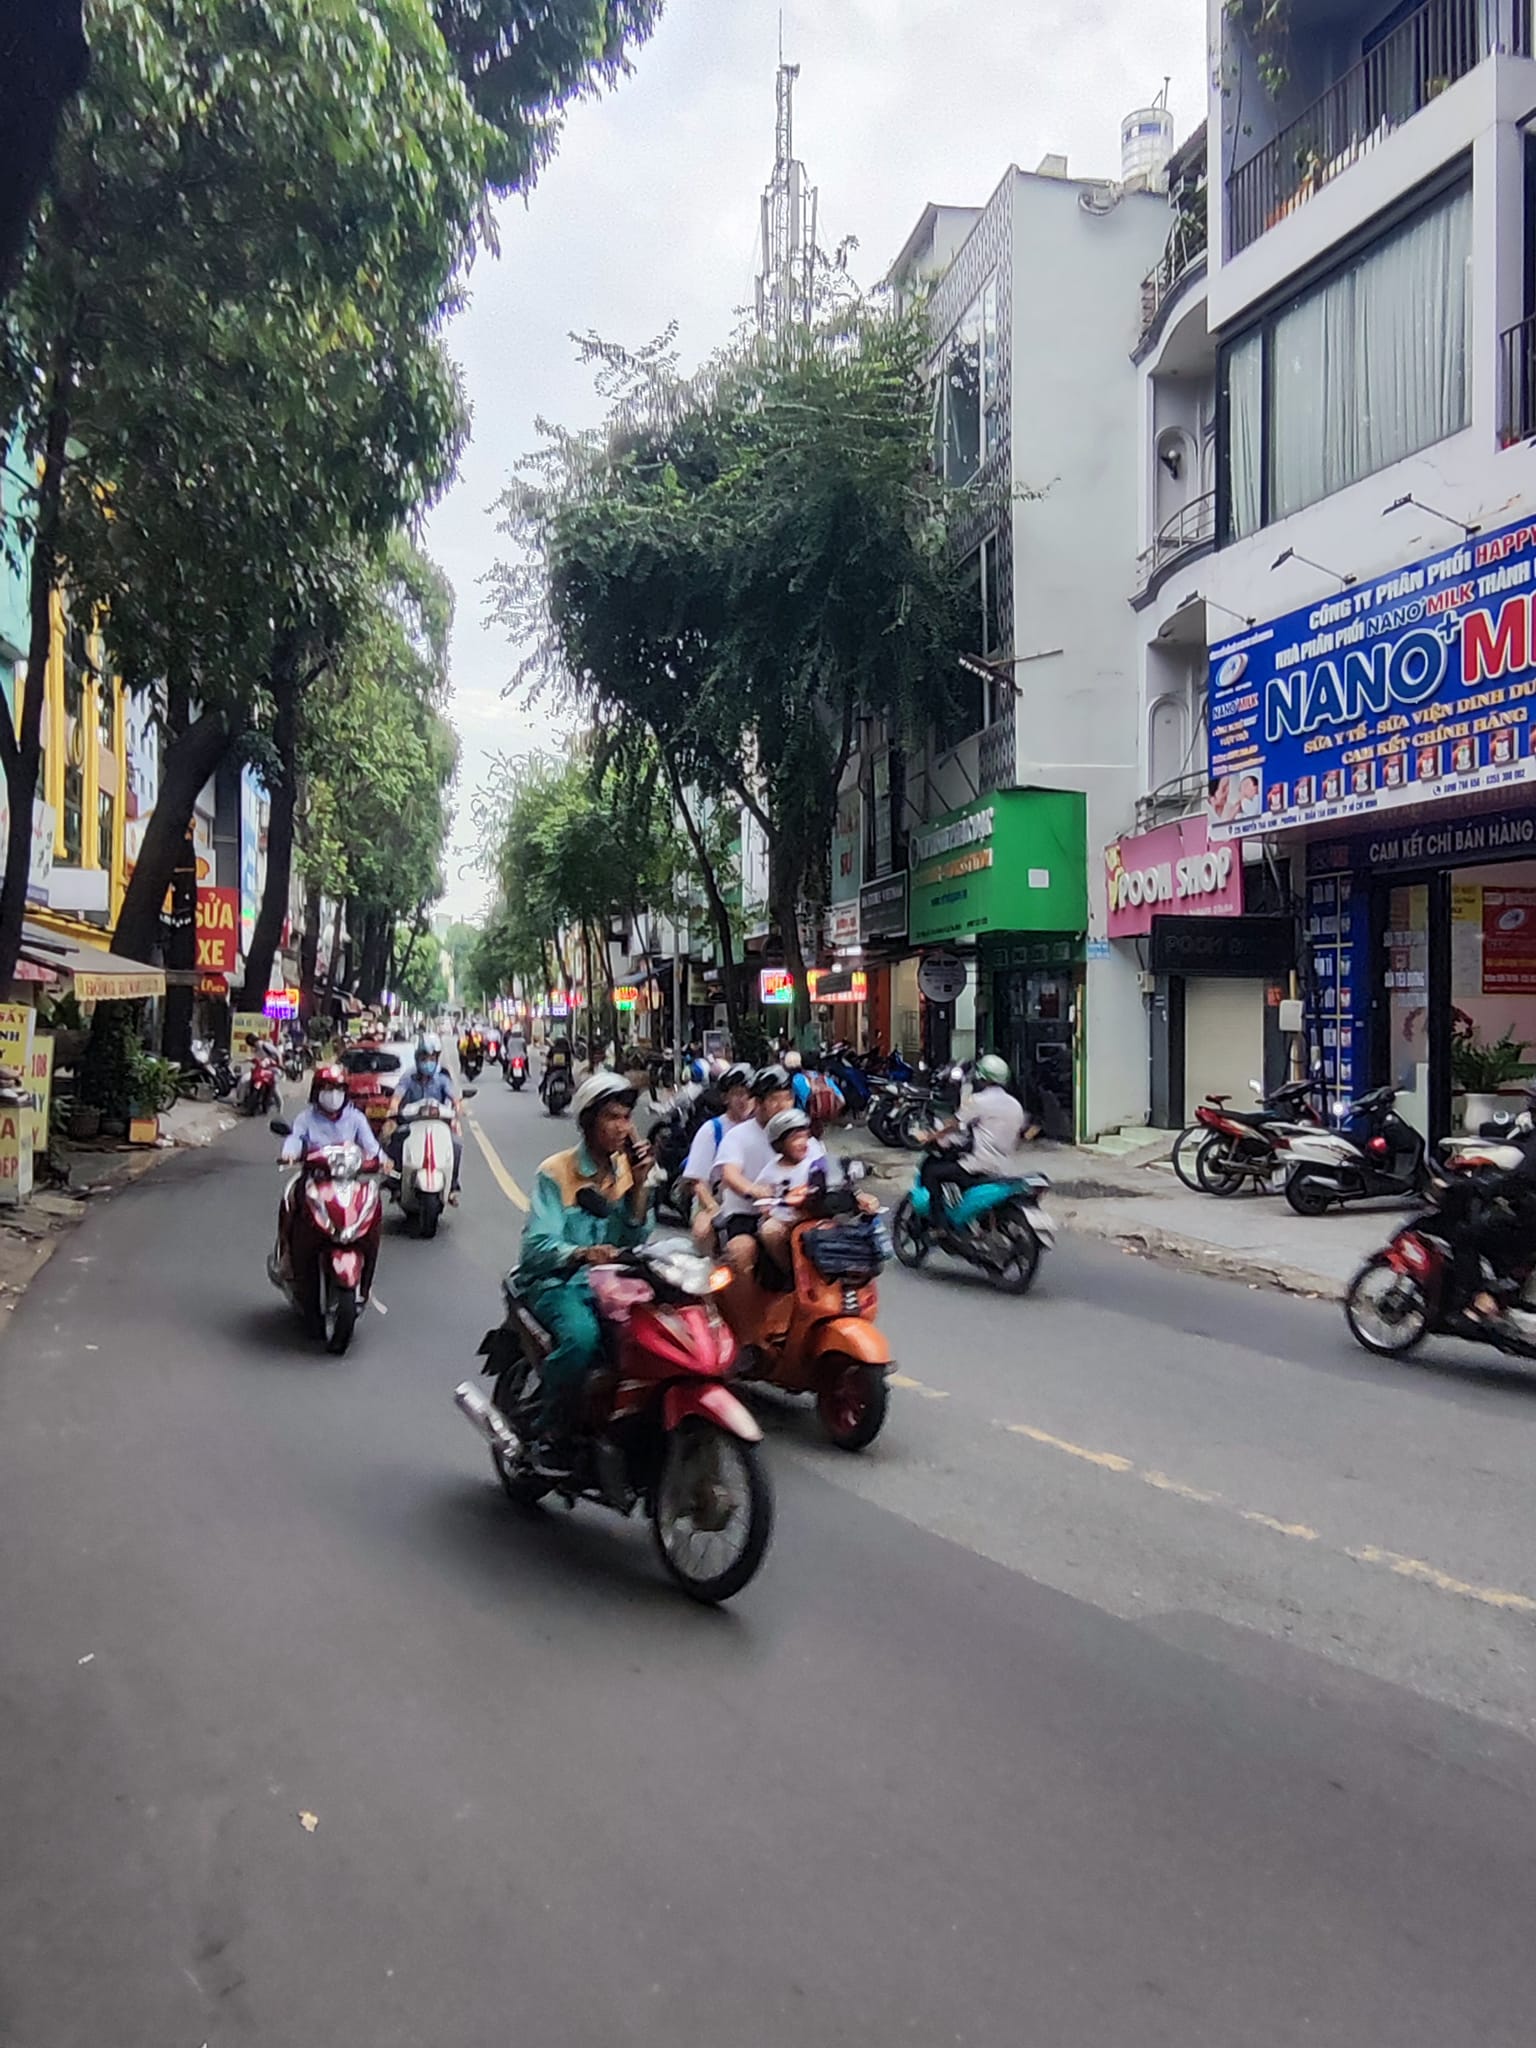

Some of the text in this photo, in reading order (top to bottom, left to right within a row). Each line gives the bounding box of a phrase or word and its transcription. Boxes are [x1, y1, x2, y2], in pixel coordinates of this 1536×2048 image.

[1275, 642, 1300, 670] NHÀ
[1301, 630, 1334, 661] PHÂN
[1335, 617, 1365, 649] PHỐI
[1426, 581, 1475, 617] MILK
[1477, 561, 1531, 598] THÀNH
[1309, 598, 1352, 630] CÔNG
[1353, 589, 1373, 613] TY
[1376, 569, 1425, 605] PHÂN
[1427, 546, 1472, 586] PHỐI
[1303, 735, 1333, 754] SỮA
[1334, 731, 1344, 746] Y
[1346, 720, 1368, 743] TẾ
[1376, 714, 1410, 735] SỮA
[1411, 702, 1455, 725] VIỆN
[1456, 687, 1506, 714] DINH
[1341, 706, 1528, 765] CAM KẾT CHÍNH HÃNG
[1369, 816, 1534, 863] CAM KẾT CHỈ BÁN HÀNG
[1118, 846, 1232, 909] POOM SHOP
[195, 891, 234, 928] SỬA
[197, 938, 225, 966] XE
